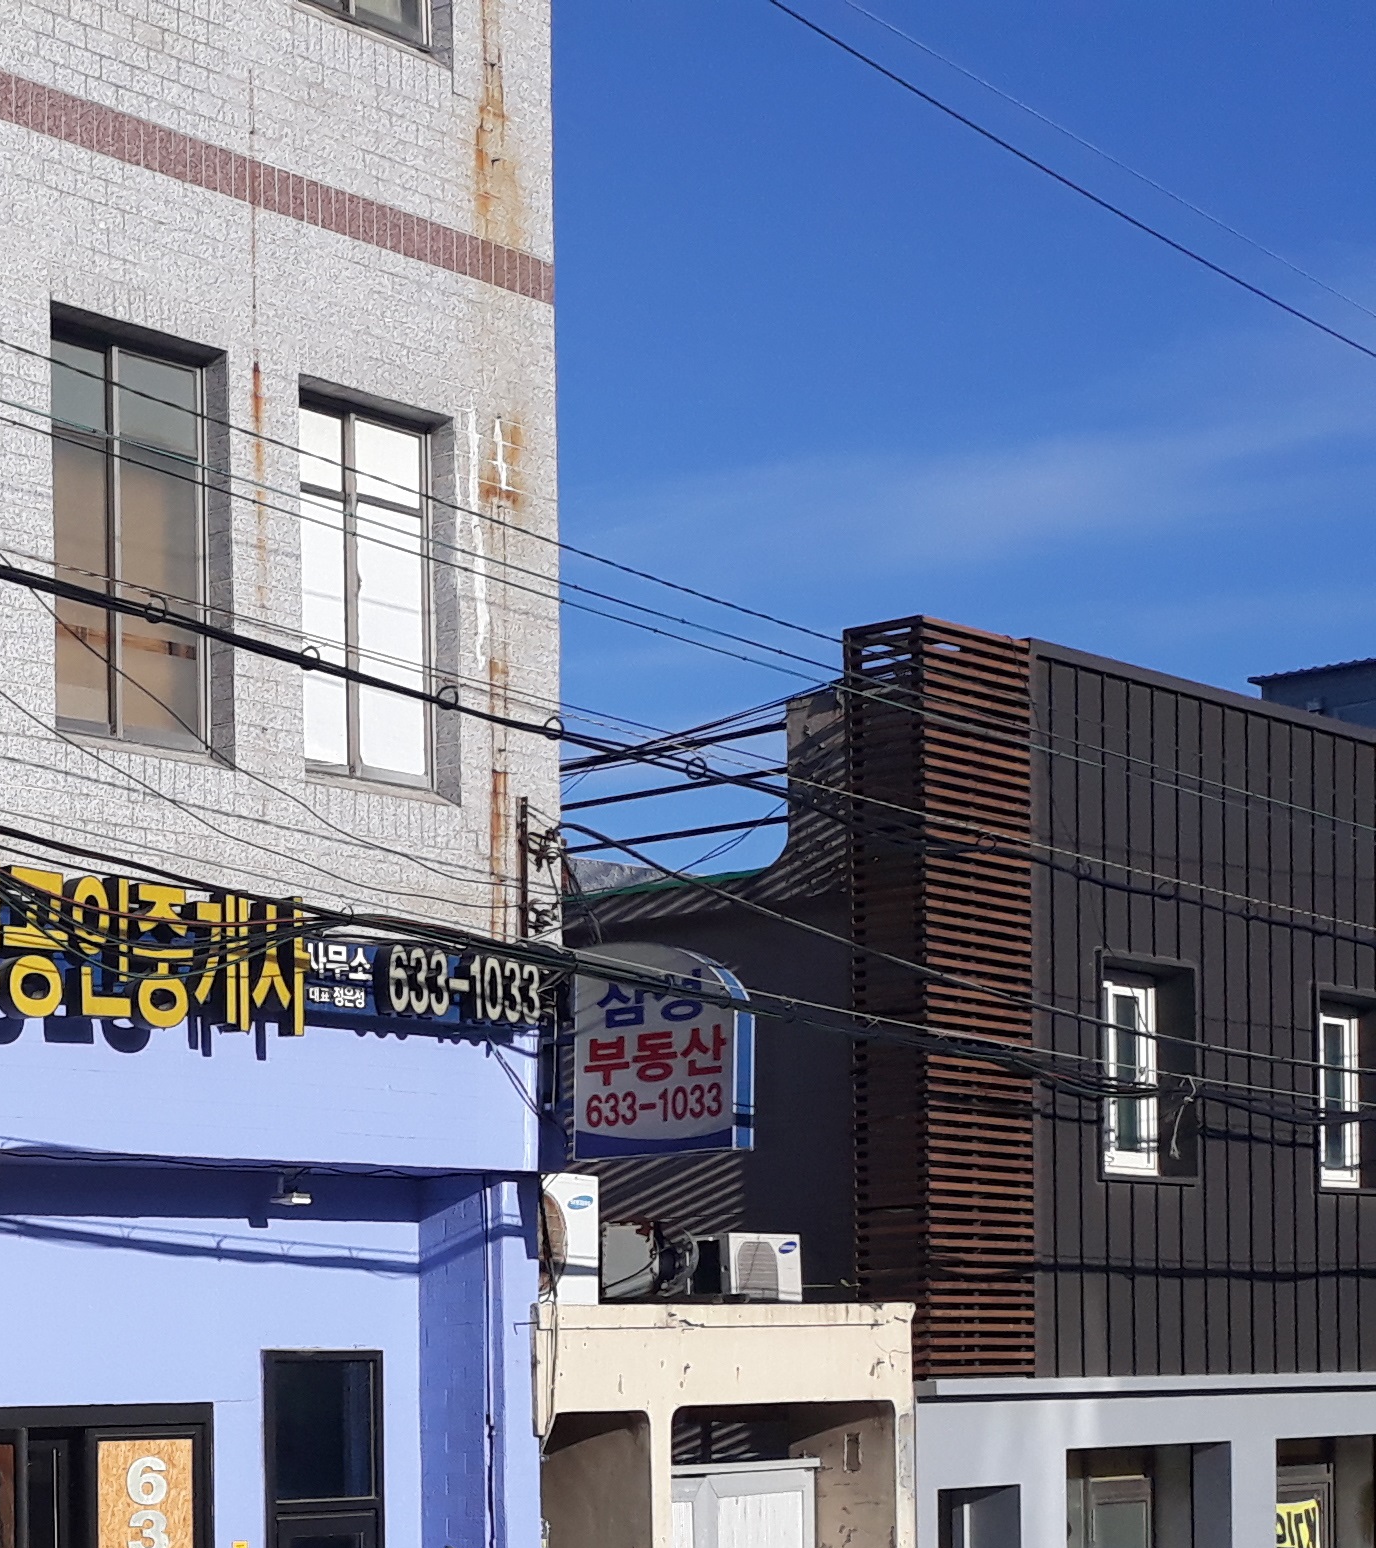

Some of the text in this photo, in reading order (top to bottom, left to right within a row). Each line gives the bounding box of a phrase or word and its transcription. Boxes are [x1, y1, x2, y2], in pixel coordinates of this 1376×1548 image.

[308, 942, 373, 981] 사무소
[389, 944, 541, 1025] 633-1033
[584, 1023, 727, 1086] 부동산
[586, 1083, 723, 1128] 633-1033
